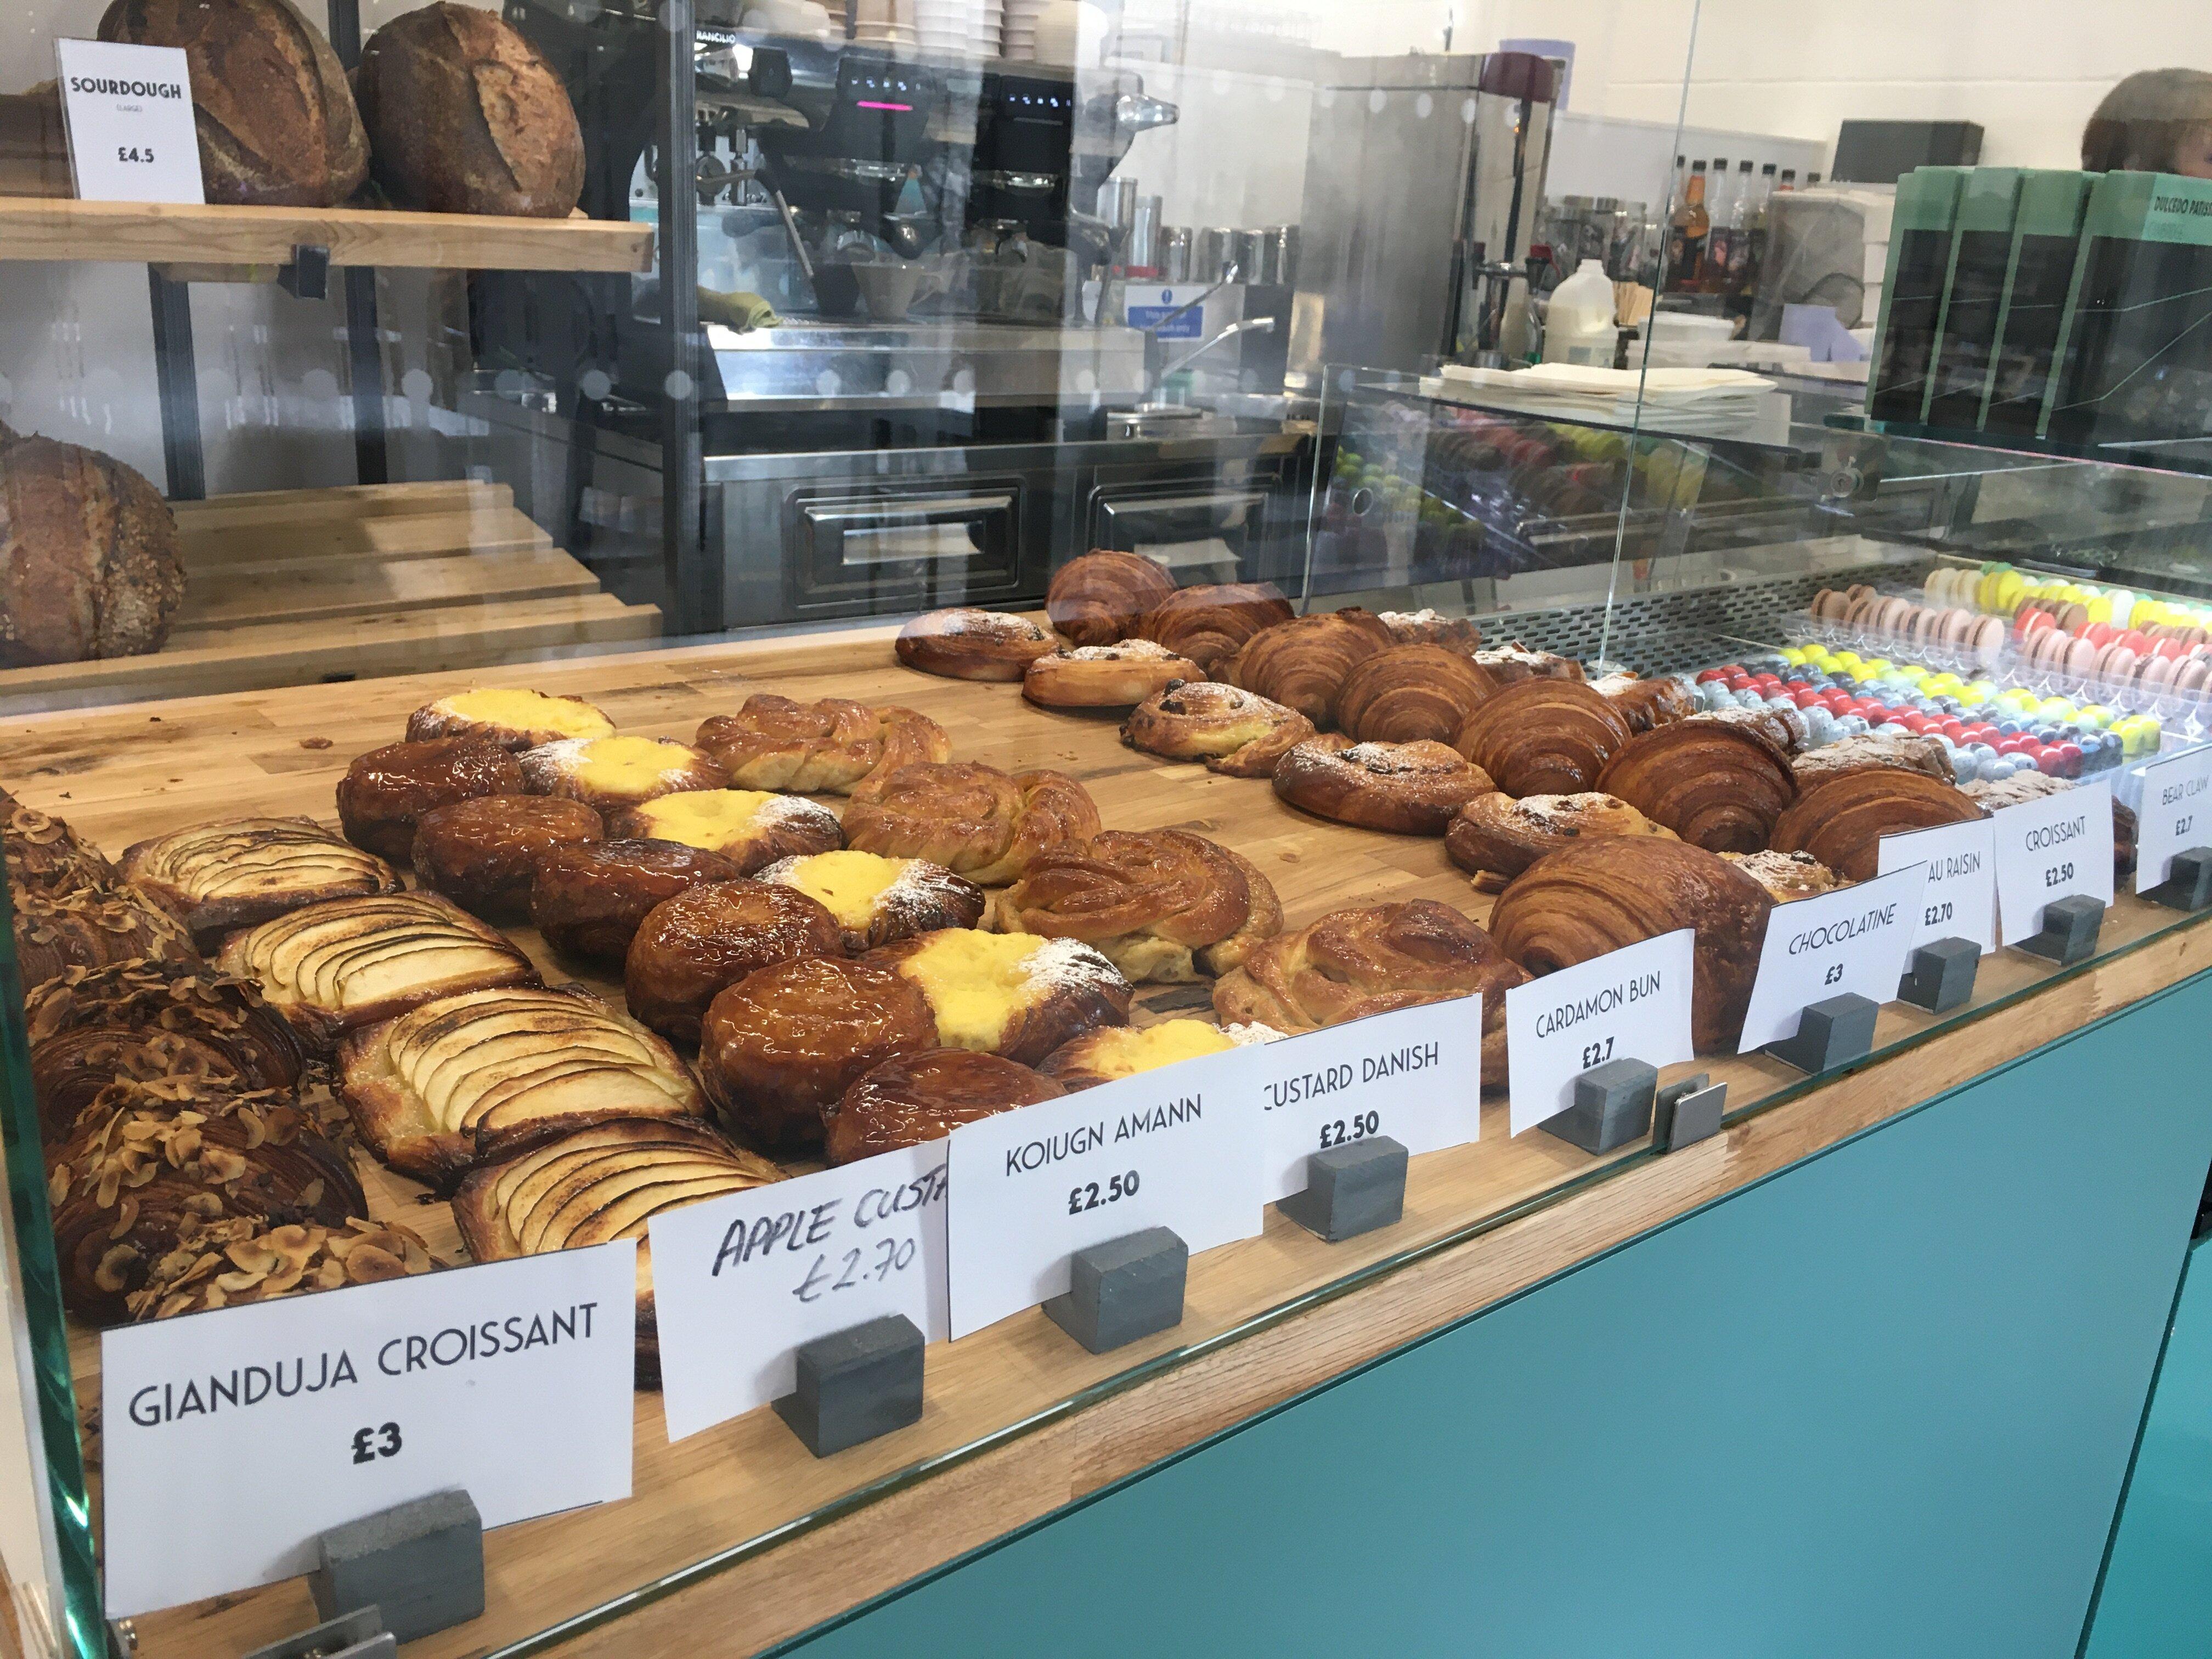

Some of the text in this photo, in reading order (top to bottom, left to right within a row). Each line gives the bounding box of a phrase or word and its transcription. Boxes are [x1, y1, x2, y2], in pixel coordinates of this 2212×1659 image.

[70, 77, 182, 99] SOURDOUGH
[118, 146, 155, 163] £4.5
[2163, 775, 2209, 805] BEAR CLAW
[2025, 815, 2085, 852] CROISSANT
[2175, 815, 2193, 836] £2.7
[1928, 850, 1980, 883] AU RAISIN
[2045, 862, 2074, 887] £2.50
[1788, 902, 1897, 955] CHOCOLATINE
[1925, 901, 1953, 926] £2.70
[1824, 963, 1843, 985] £3
[1536, 970, 1660, 1038] CARDAMON BUN
[1363, 1041, 1438, 1083] DANISH
[1582, 1036, 1615, 1070] £2.7
[1006, 1093, 1201, 1177] KOIUGN AMANN
[1319, 1110, 1379, 1149] £2.50
[1068, 1170, 1140, 1215] £2.50
[712, 1198, 843, 1277] APPLE
[792, 1237, 916, 1303] £2.70
[128, 1302, 598, 1427] GIANDUJA CROISSANT
[351, 1421, 403, 1465] £3
